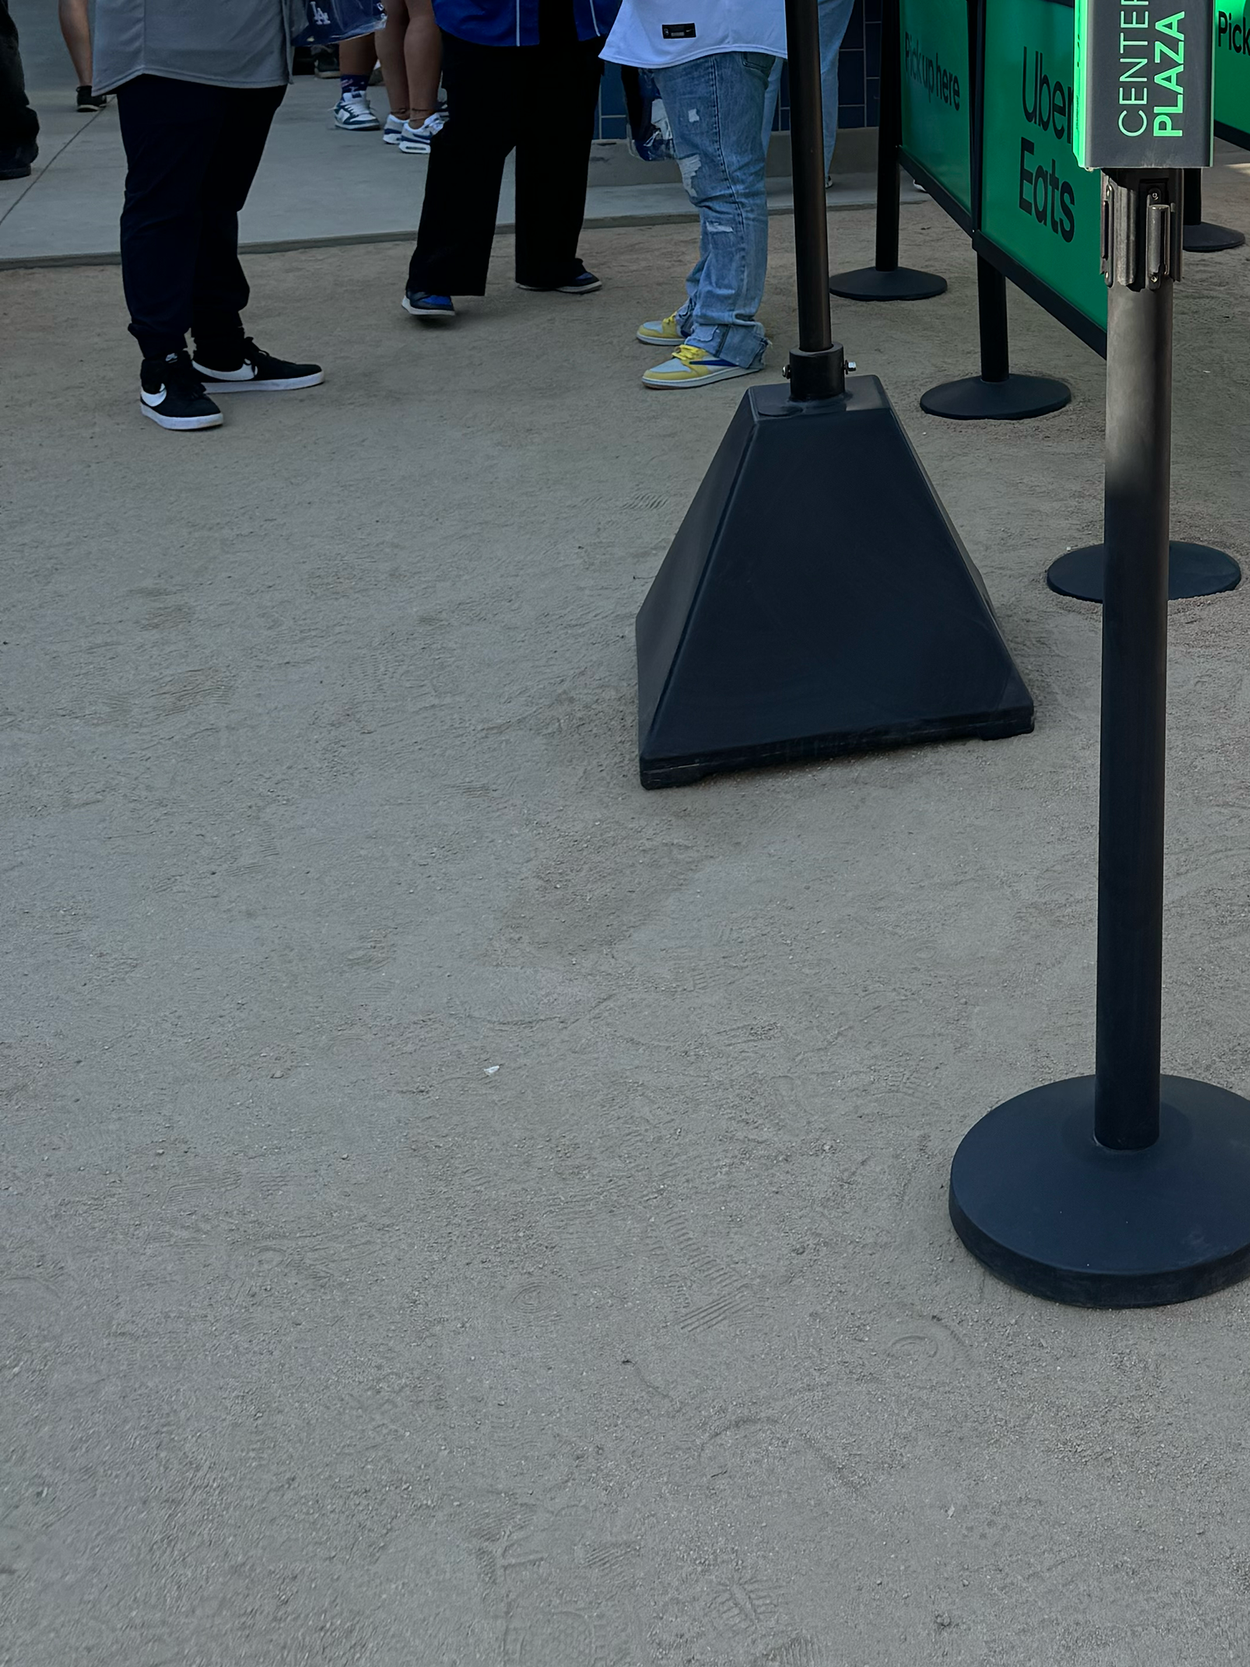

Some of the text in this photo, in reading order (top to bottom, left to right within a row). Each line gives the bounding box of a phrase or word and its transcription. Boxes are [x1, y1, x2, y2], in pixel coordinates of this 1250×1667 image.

[905, 32, 960, 111] Pick up here
[1153, 11, 1185, 137] PLAZA
[1018, 136, 1075, 243] Eats
